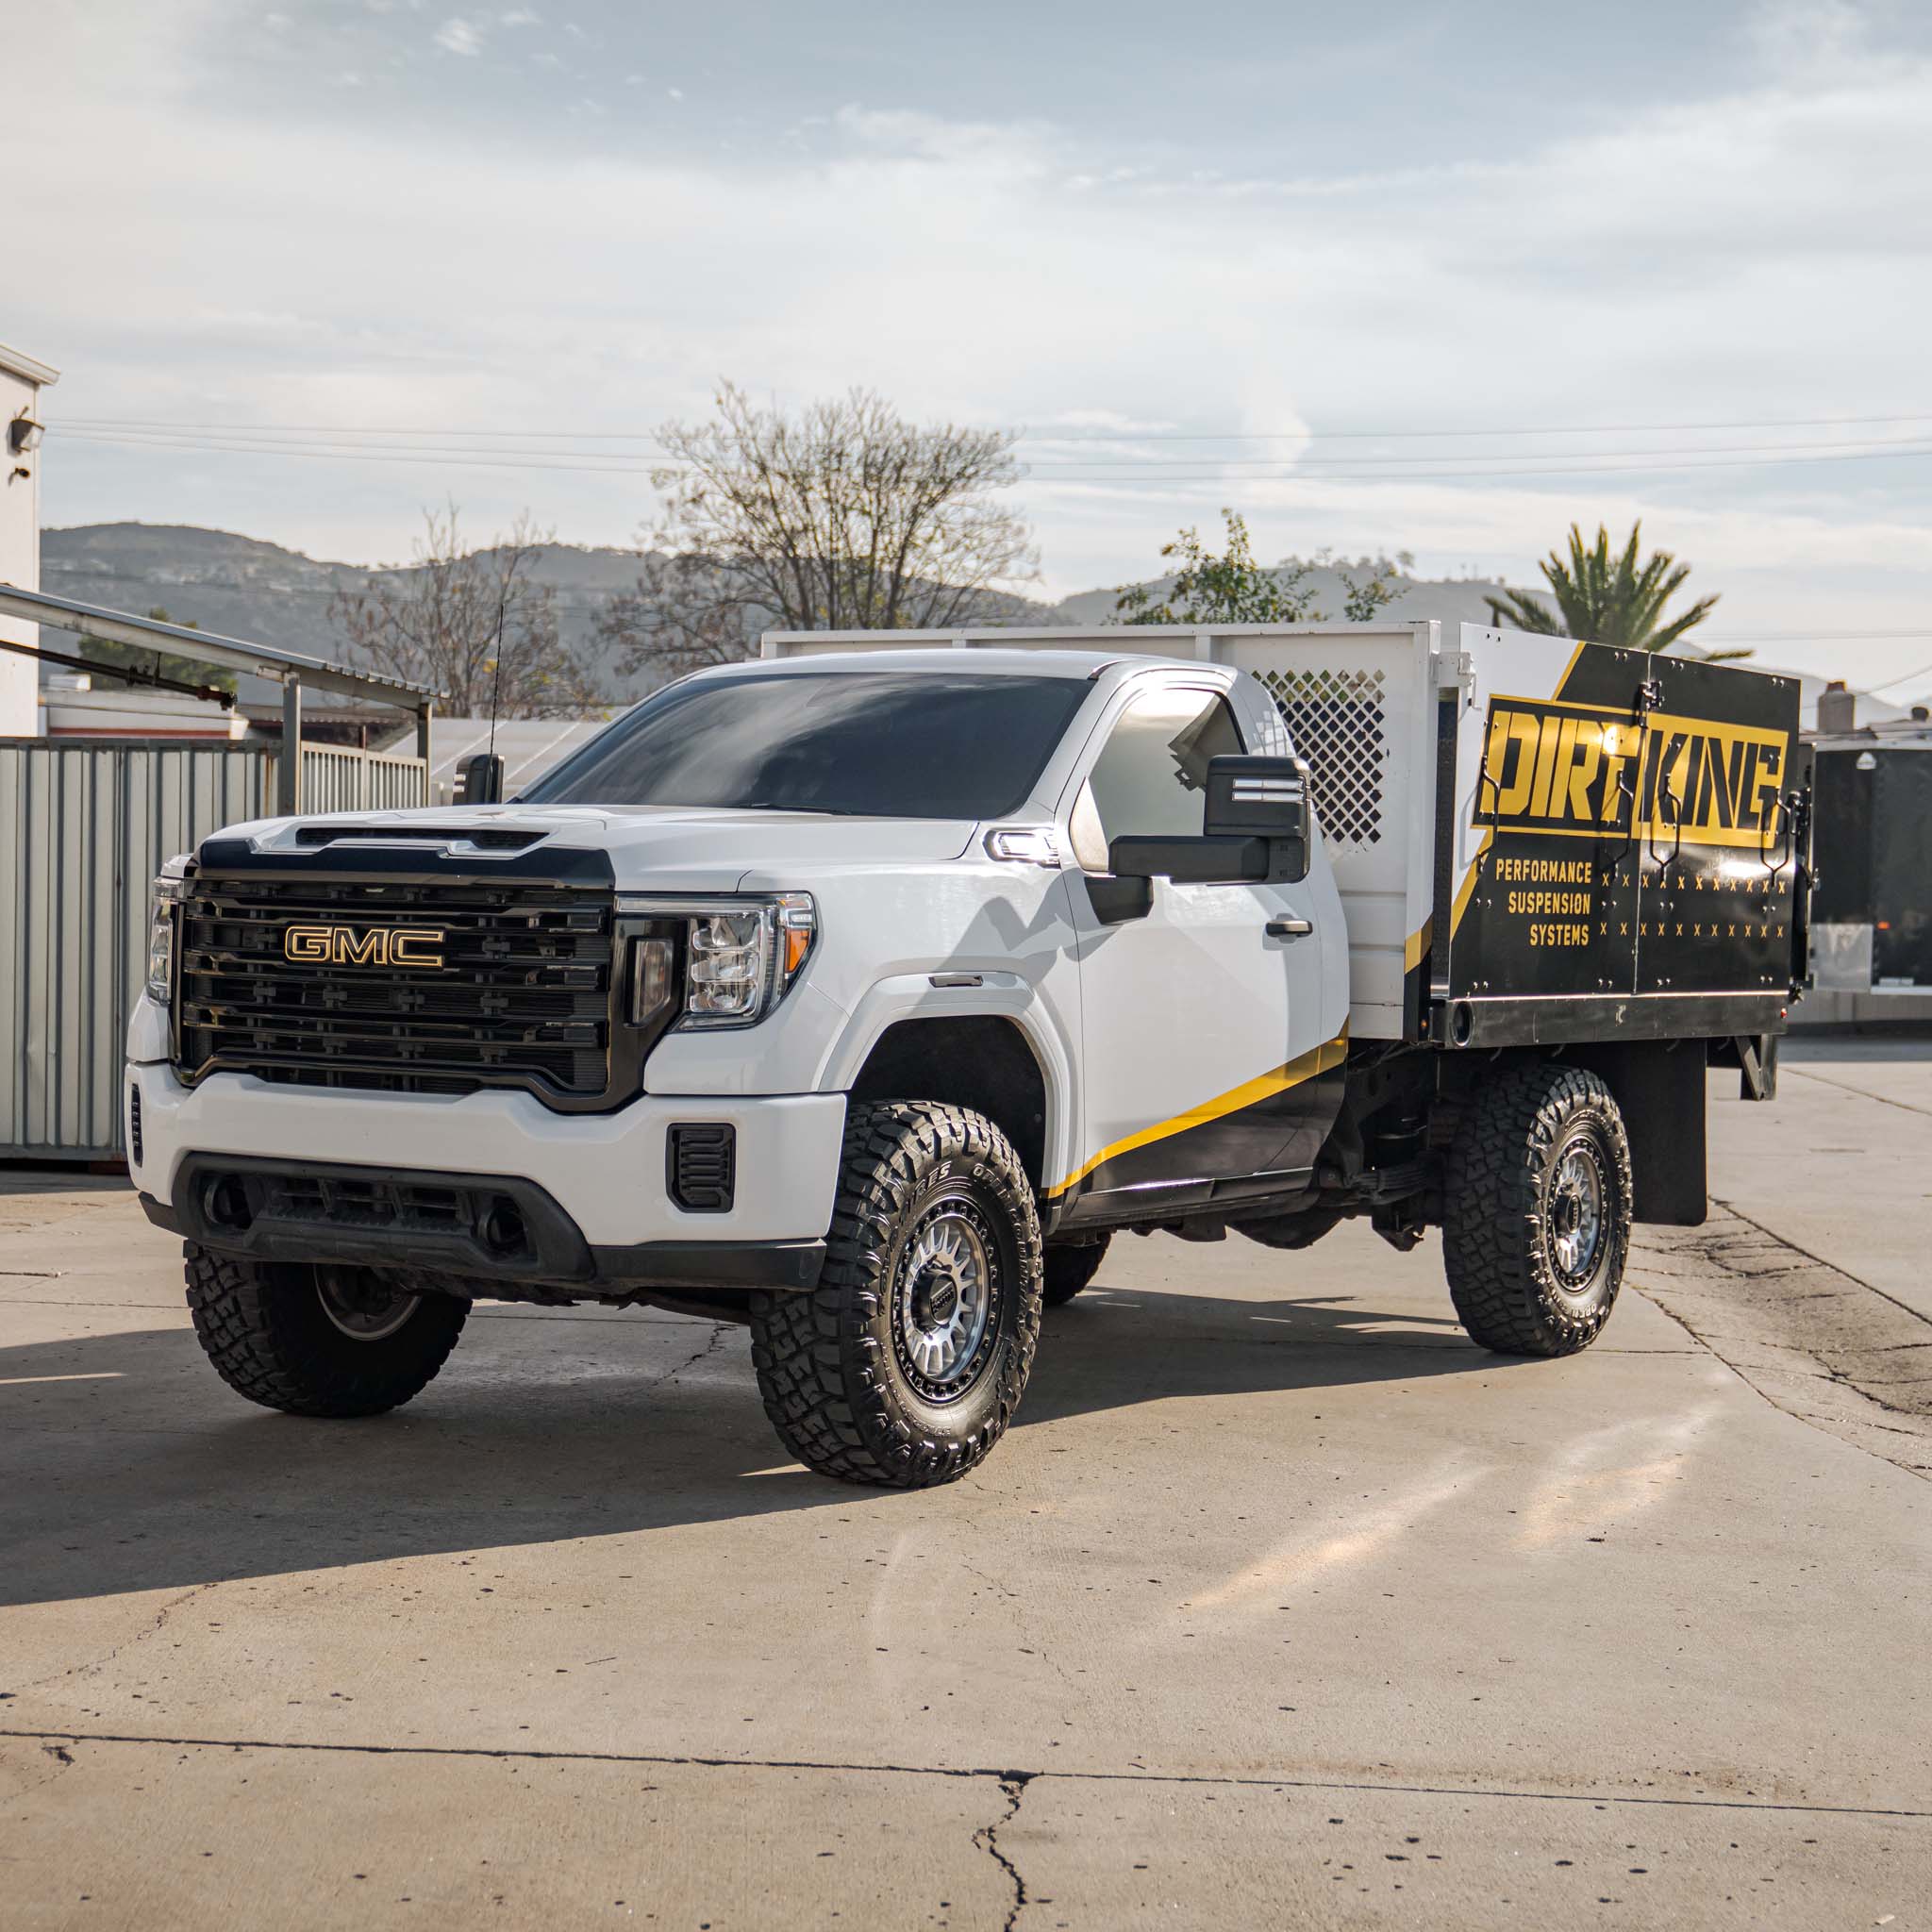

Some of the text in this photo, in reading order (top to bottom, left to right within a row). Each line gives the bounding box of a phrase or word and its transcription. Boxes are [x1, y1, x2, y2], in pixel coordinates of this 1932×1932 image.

[1479, 709, 1782, 830] DIRT KING
[1495, 858, 1592, 884] PERFORMANCE
[1508, 891, 1591, 915] SUSPENSION
[285, 926, 444, 967] GMC
[1530, 923, 1590, 946] SYSTEMS
